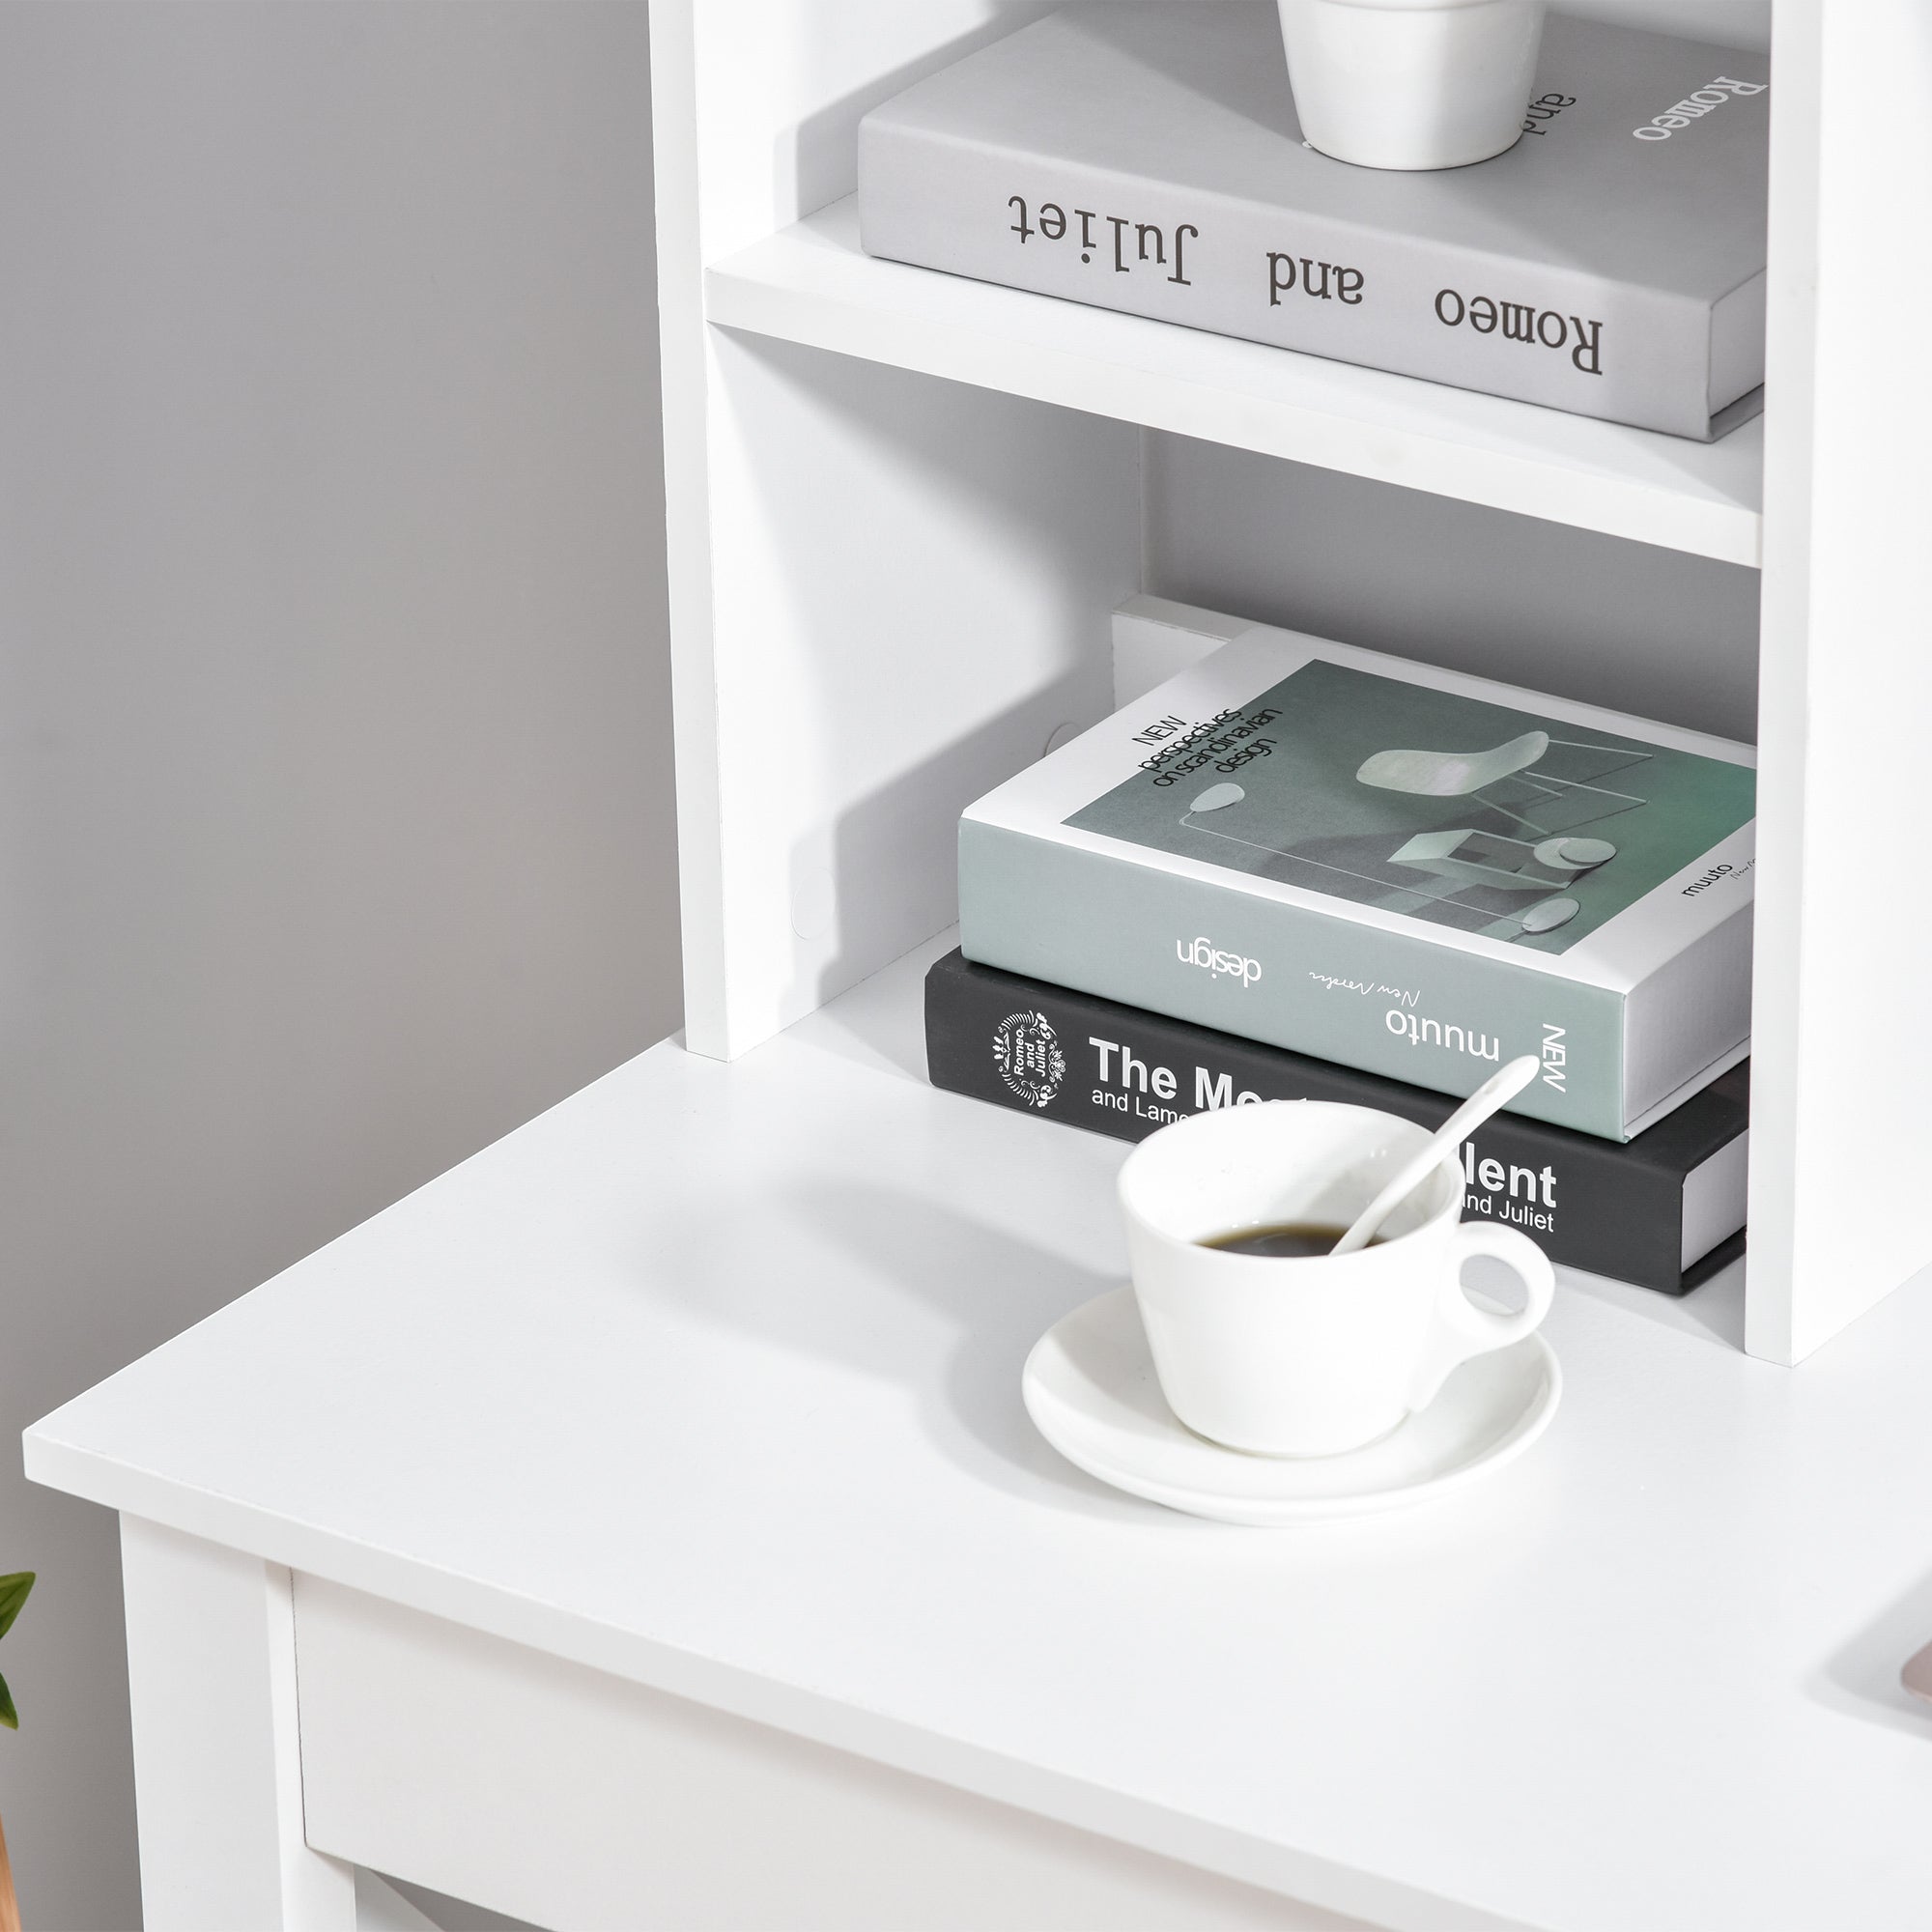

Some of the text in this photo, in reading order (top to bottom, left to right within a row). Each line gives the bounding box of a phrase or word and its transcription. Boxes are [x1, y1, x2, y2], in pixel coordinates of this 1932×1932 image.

[1633, 75, 1769, 141] Romeo
[1008, 196, 1604, 376] Romeo and Juliet
[1131, 715, 1187, 746] NEW
[1138, 708, 1241, 773] perspectives
[1152, 708, 1283, 787] on scandinavian
[1213, 738, 1278, 774] design
[1681, 864, 1733, 896] muuto
[1176, 937, 1263, 988] design
[1013, 1029, 1025, 1076] Romeo
[1024, 1042, 1035, 1068] and
[1035, 1038, 1046, 1078] Juliet
[1385, 1009, 1499, 1062] muuto
[1542, 1022, 1567, 1094] NEW
[1089, 1037, 1178, 1100] The
[1465, 1141, 1557, 1208] lent
[1092, 1087, 1128, 1112] and
[1463, 1192, 1492, 1215] nd
[1498, 1200, 1554, 1233] Juliet
